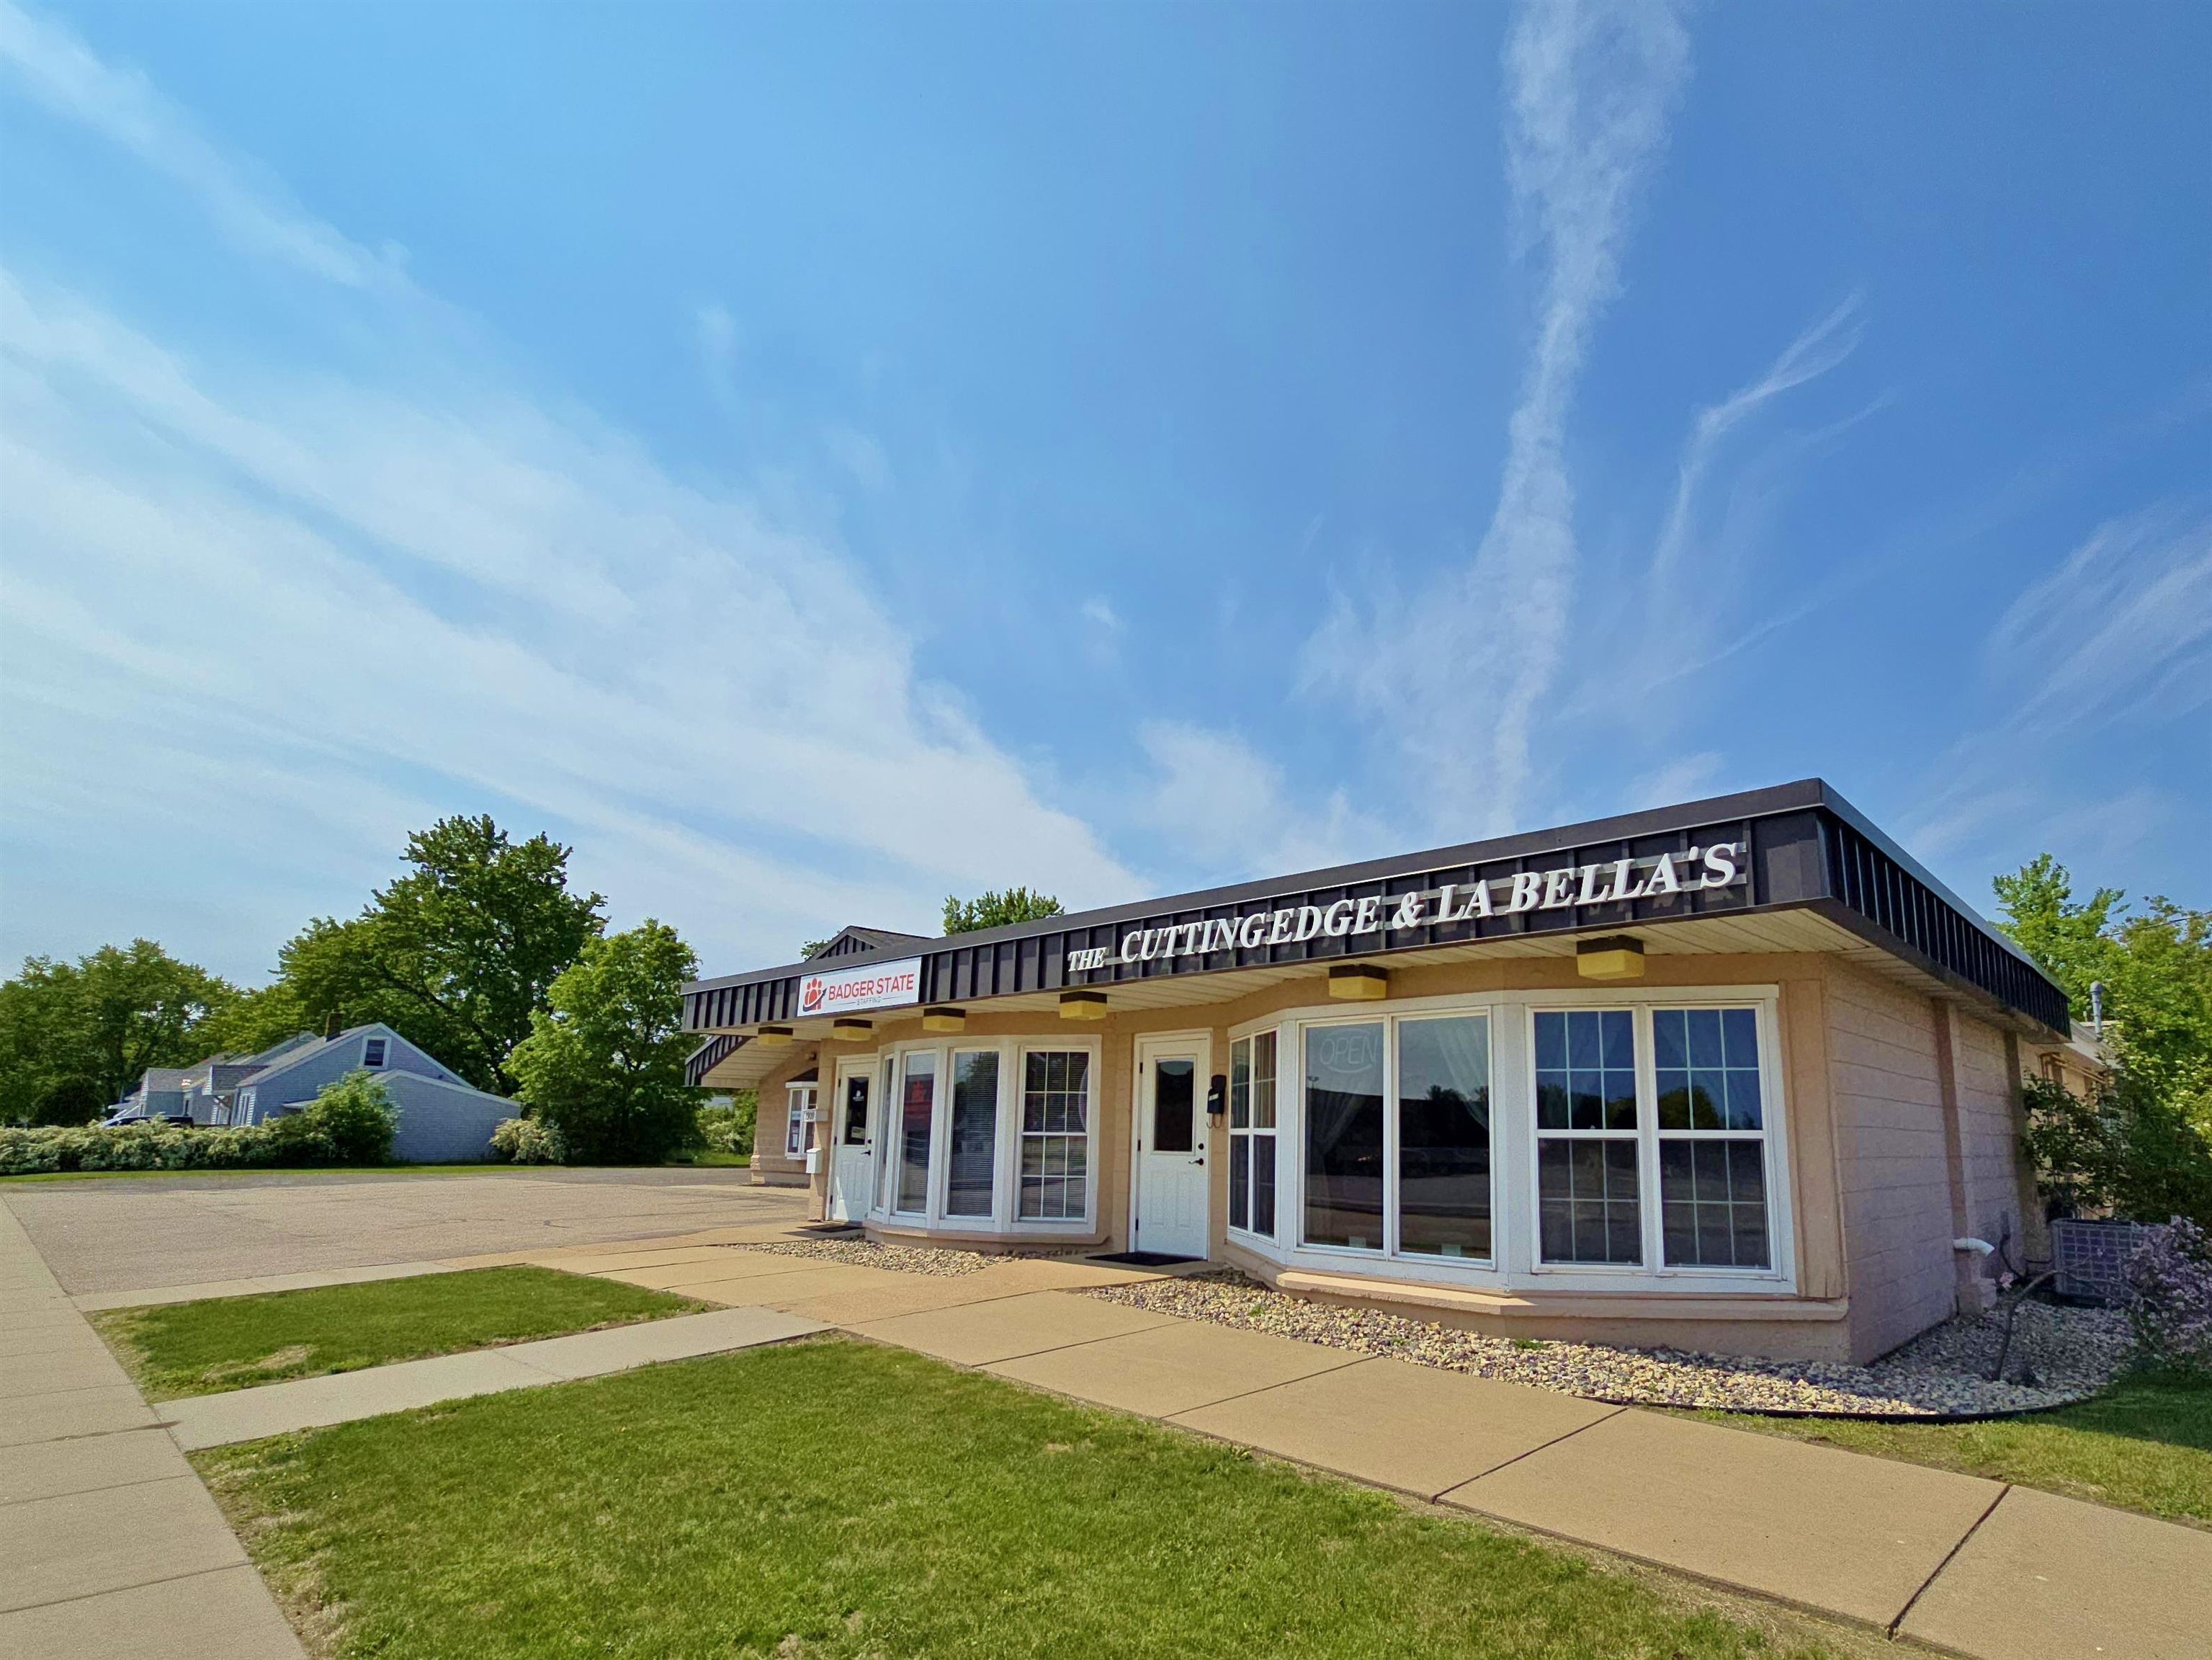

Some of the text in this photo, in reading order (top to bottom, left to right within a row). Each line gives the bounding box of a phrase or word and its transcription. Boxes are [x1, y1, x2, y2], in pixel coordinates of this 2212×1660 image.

[1068, 947, 1107, 971] THE
[1392, 892, 1424, 929] &
[1434, 880, 1495, 924] LA
[1505, 842, 1738, 913] BELLA'S
[828, 973, 915, 1001] BADGER STATE
[856, 996, 882, 1006] STAFFING
[1320, 1035, 1379, 1066] OPEN
